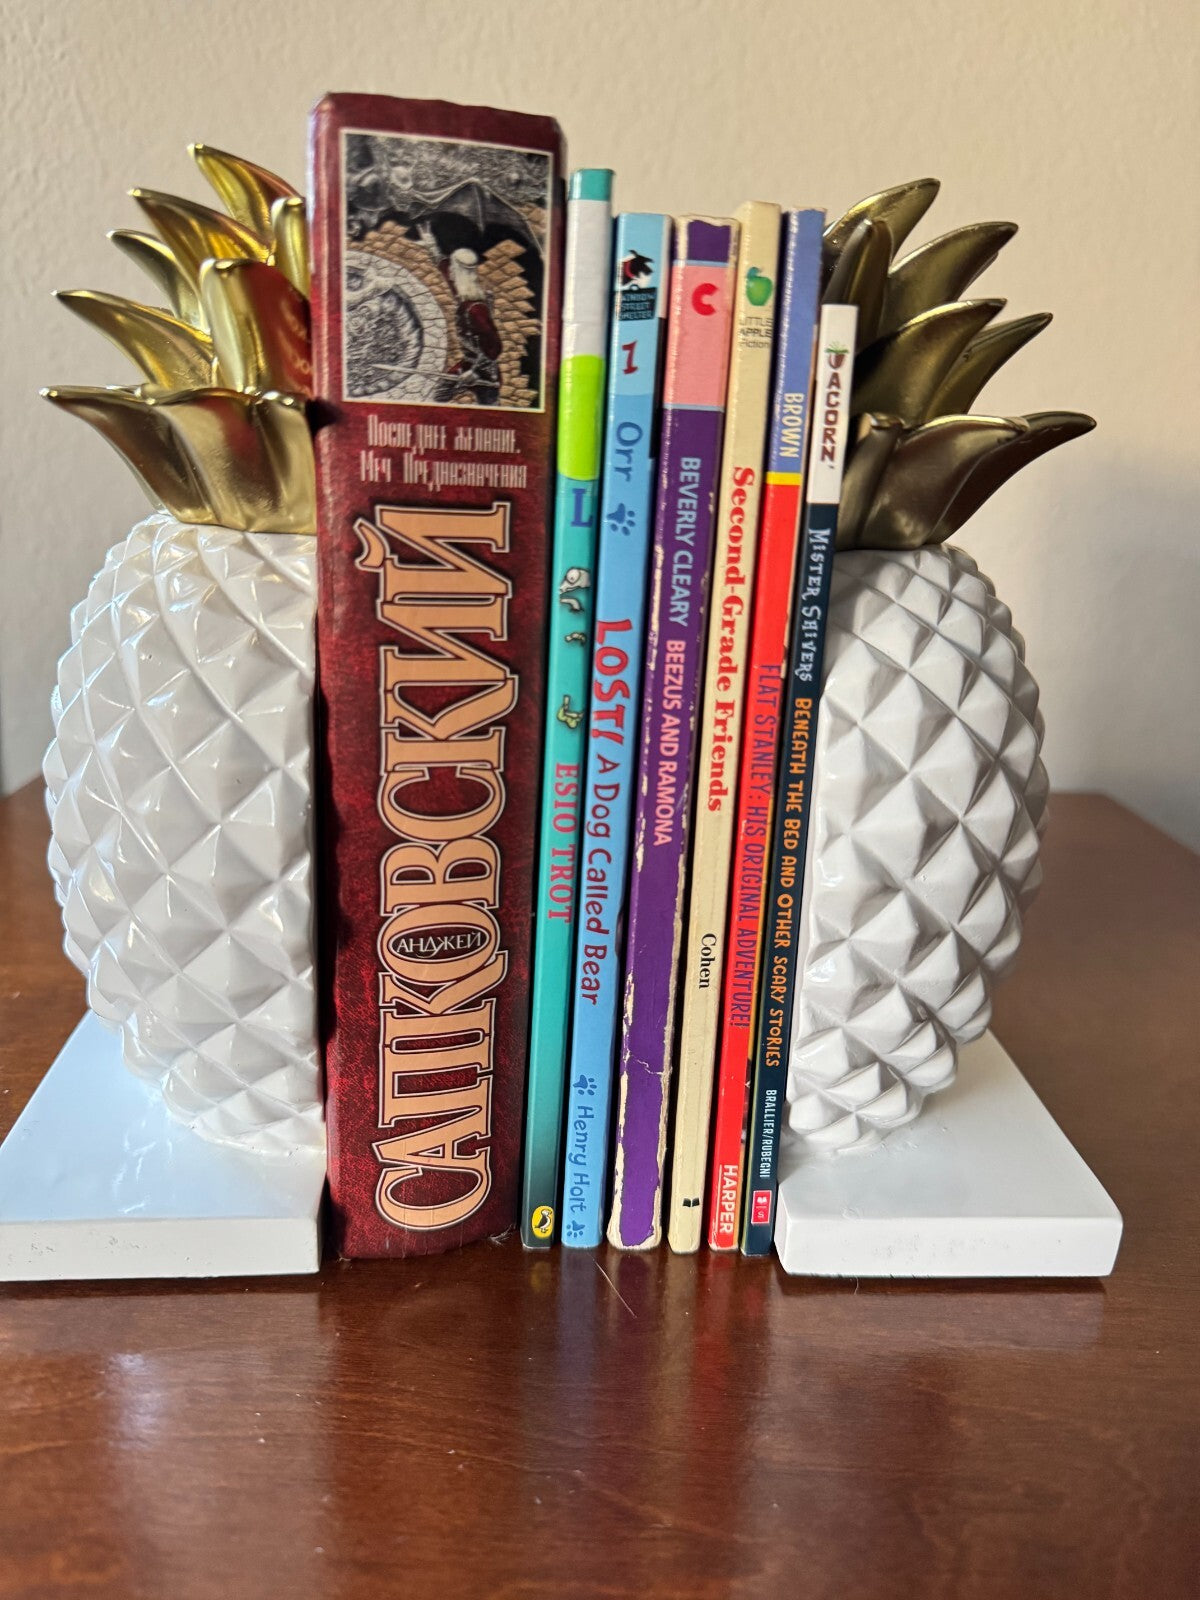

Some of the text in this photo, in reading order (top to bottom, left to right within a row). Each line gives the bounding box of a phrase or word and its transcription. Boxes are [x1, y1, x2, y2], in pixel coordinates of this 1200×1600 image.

[739, 328, 773, 338] APPLE
[614, 421, 643, 482] Orr
[779, 392, 805, 458] BROWN
[820, 372, 842, 462] ACORN
[668, 457, 701, 627] BEVERLY CLEARY
[708, 466, 755, 812] Second-Grade Friends
[653, 640, 687, 846] BEEZUS AND RAMONA
[353, 502, 519, 1230] САПКОВСКИЙ
[548, 762, 580, 923] ESIO TROT
[581, 619, 633, 1005] LOST! A Dog Called Bear
[729, 664, 782, 1028] FLAT STANLEY: HIS ORIGINAL ADVENTURE!
[397, 931, 482, 958] АНДЖЕЙ
[765, 698, 813, 1067] BENEATH THE BED AND OTHER SCARY STORIES
[699, 933, 718, 989] Cohen
[568, 1105, 594, 1213] Henry Holt
[719, 1164, 738, 1234] HARPER
